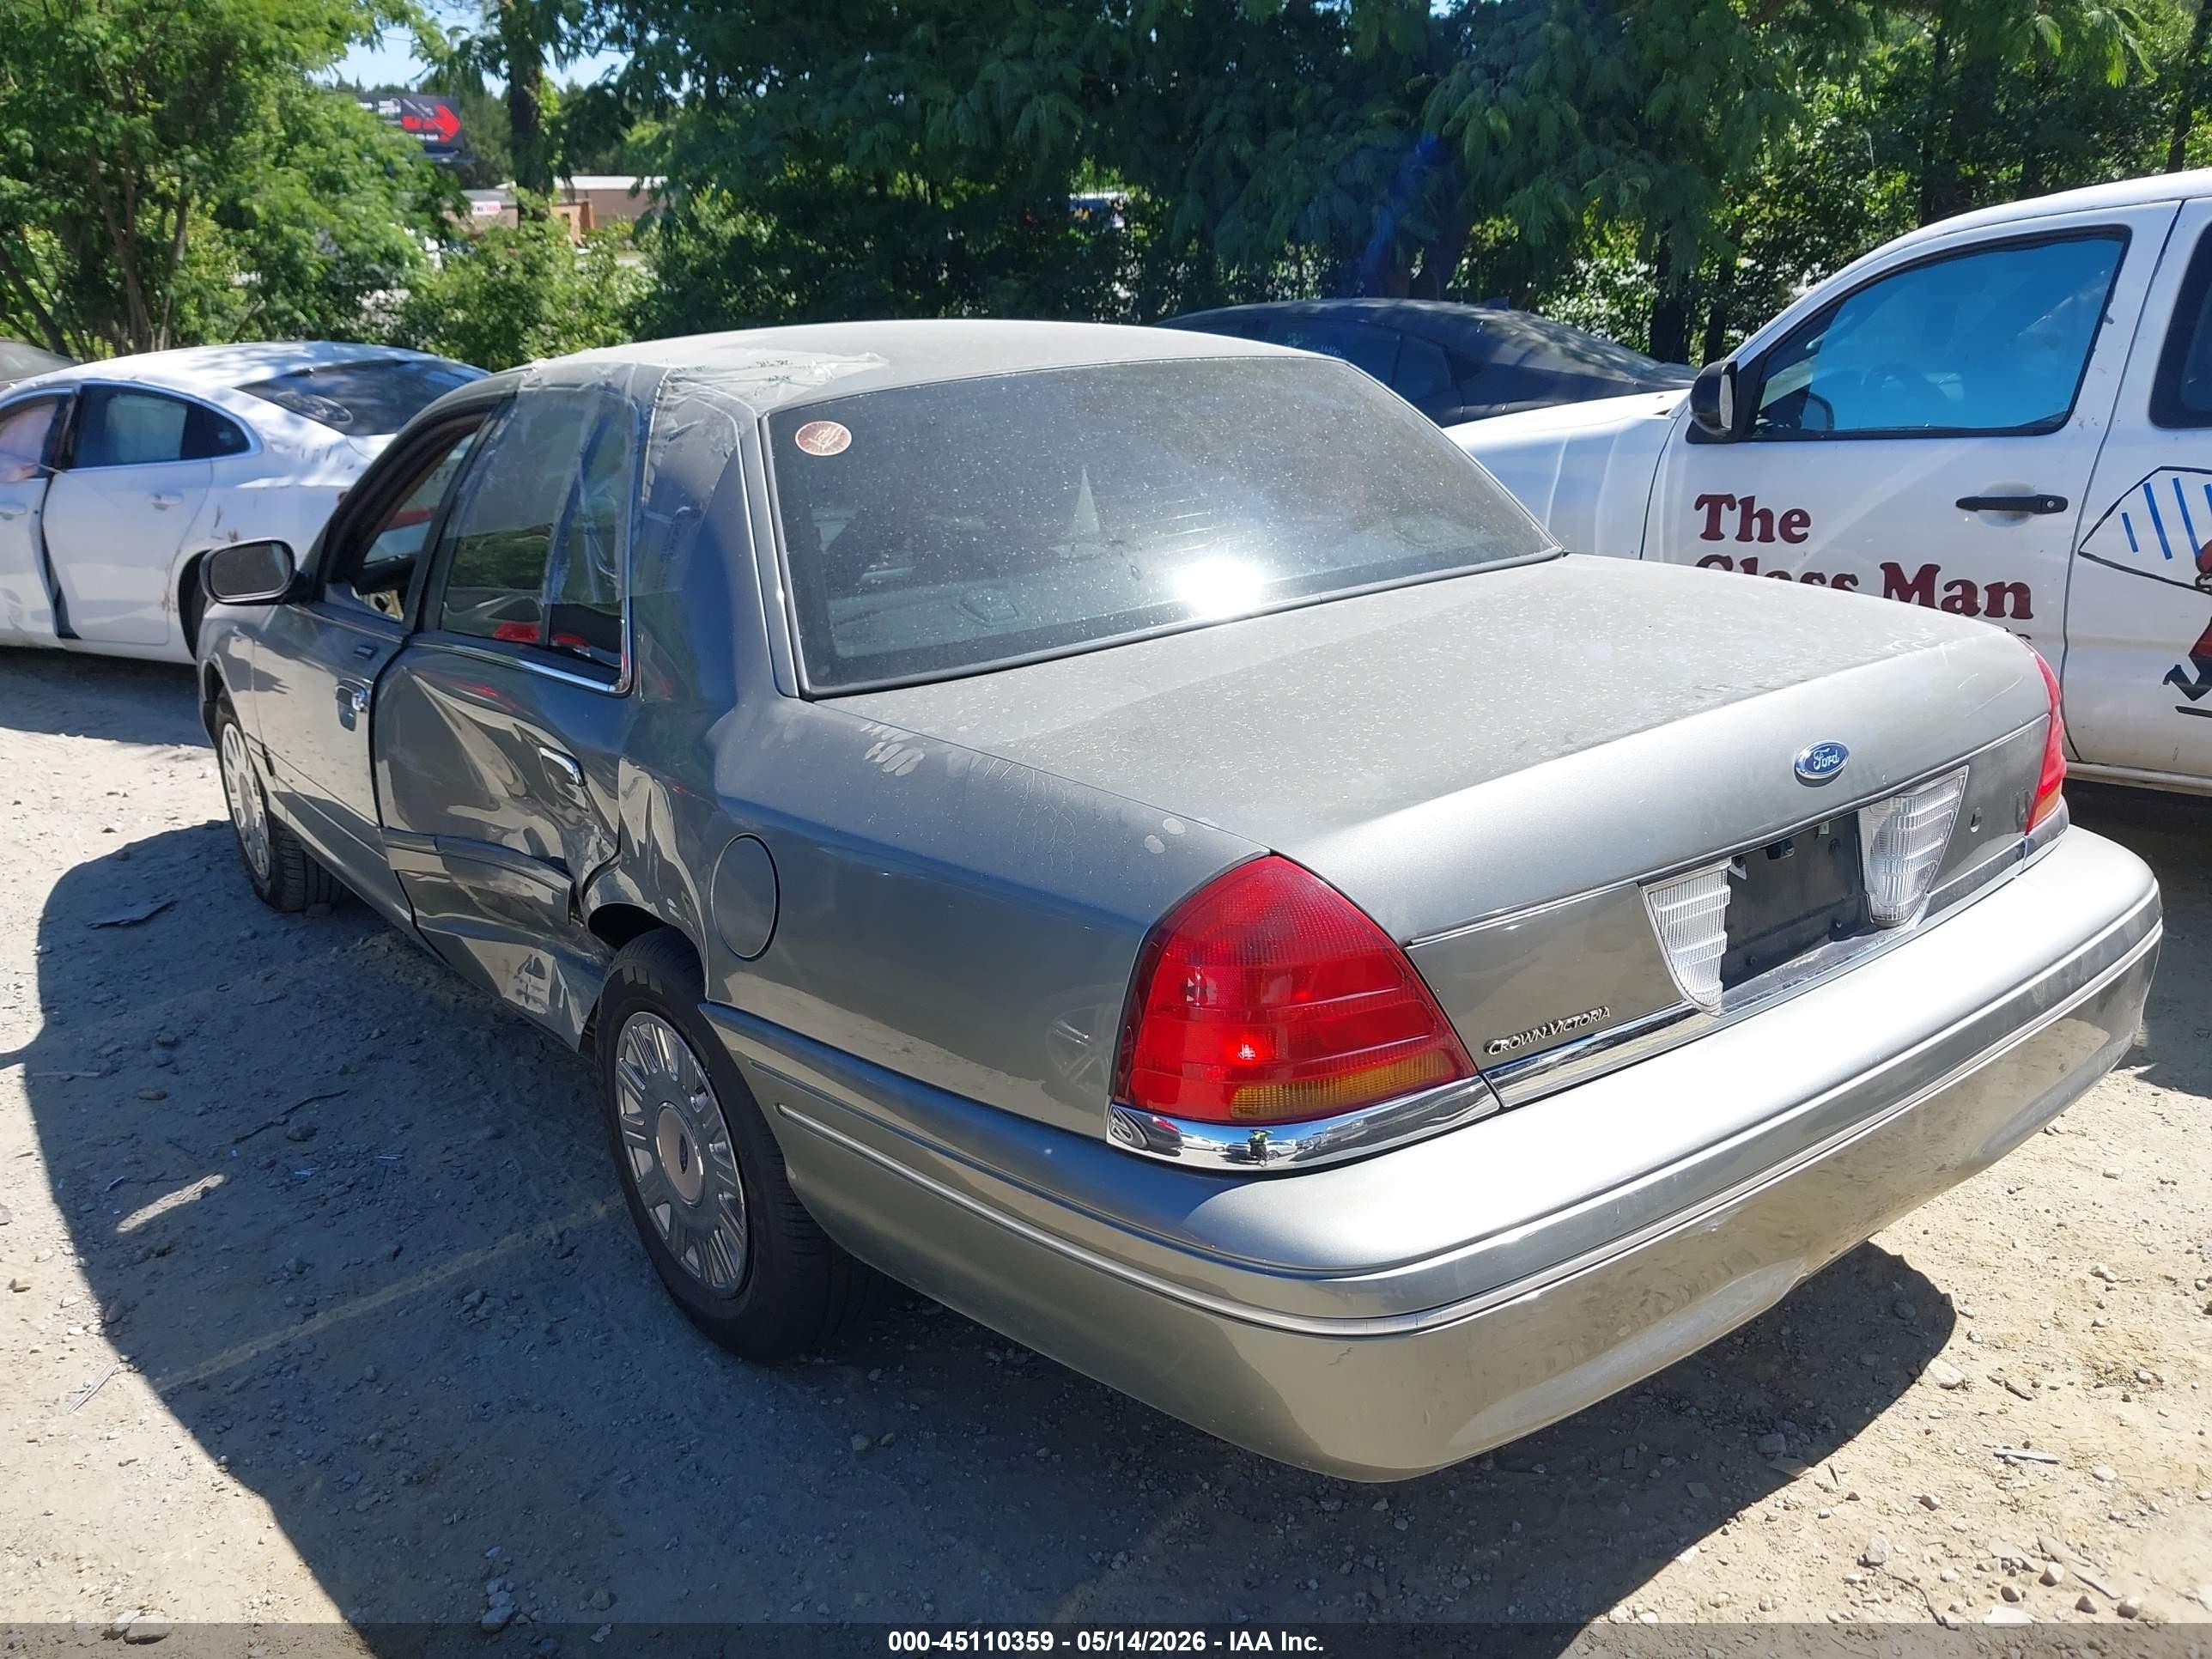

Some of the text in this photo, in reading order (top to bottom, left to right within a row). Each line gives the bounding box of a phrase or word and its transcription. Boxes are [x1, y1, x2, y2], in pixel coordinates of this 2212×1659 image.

[1694, 493, 1812, 544] The
[1879, 562, 2034, 620] Man
[1813, 747, 1840, 770] Ford
[1486, 1006, 1611, 1056] CROWN VICTORIA
